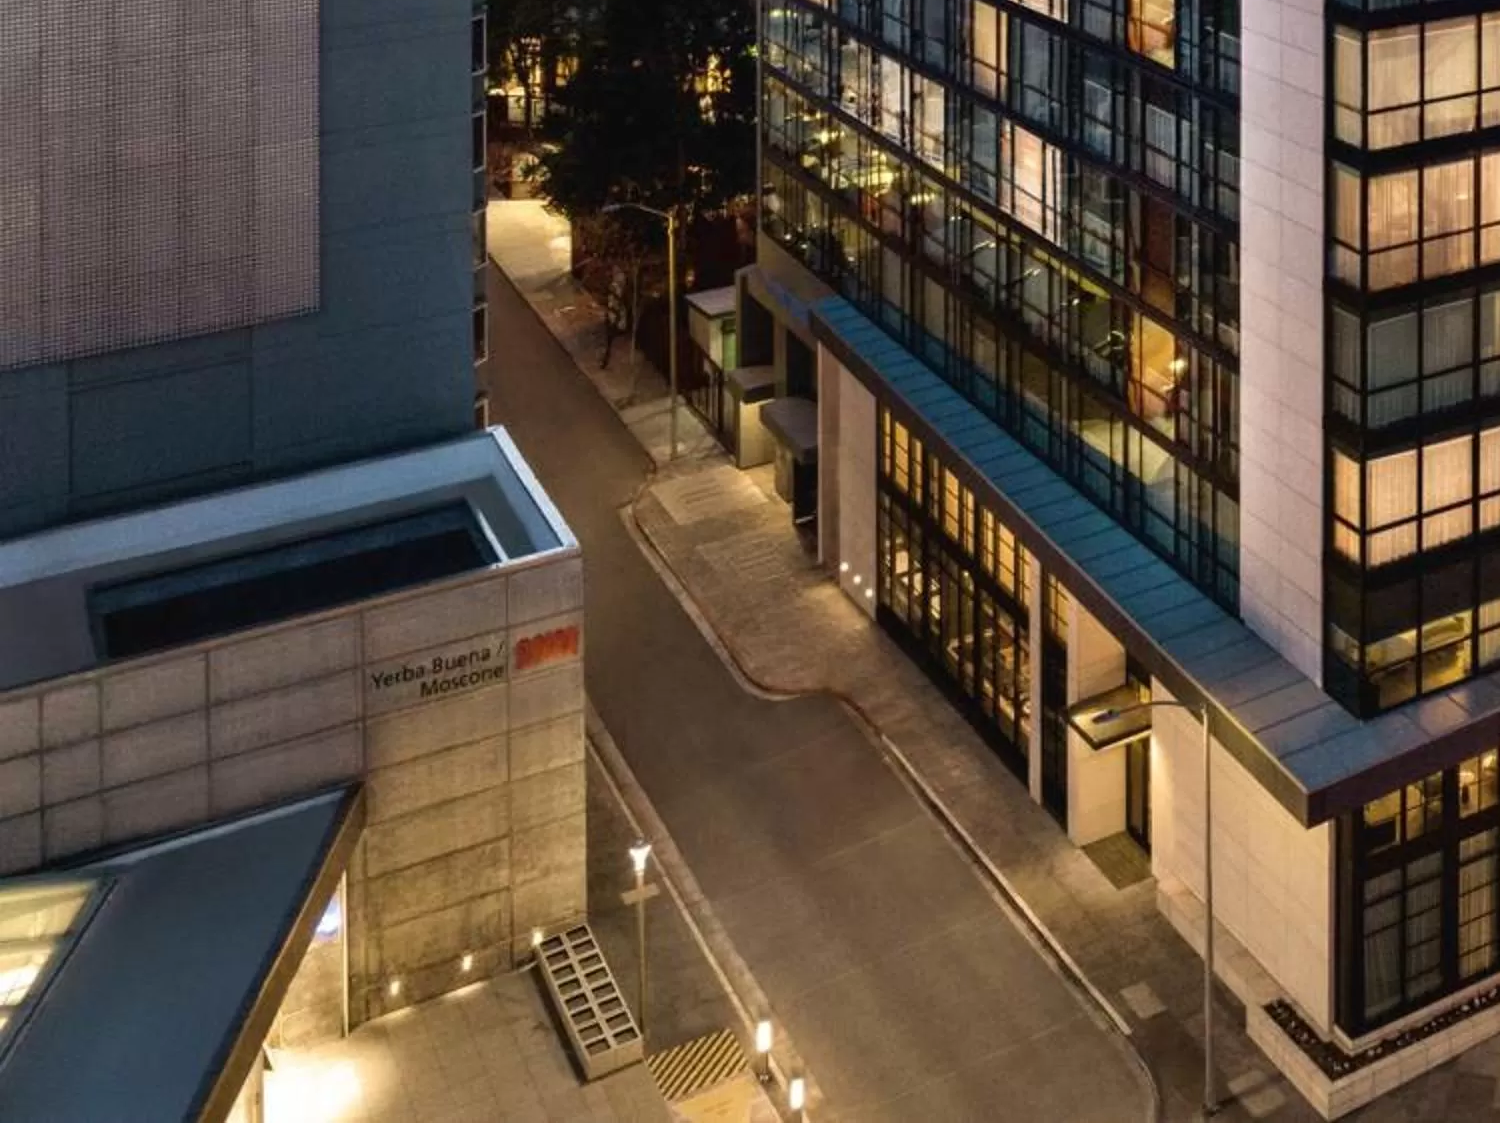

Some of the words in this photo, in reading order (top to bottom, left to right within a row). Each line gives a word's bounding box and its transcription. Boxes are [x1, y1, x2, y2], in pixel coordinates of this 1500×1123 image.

[372, 664, 425, 689] Yerba
[432, 648, 491, 674] Buena
[420, 666, 505, 697] Moscone
